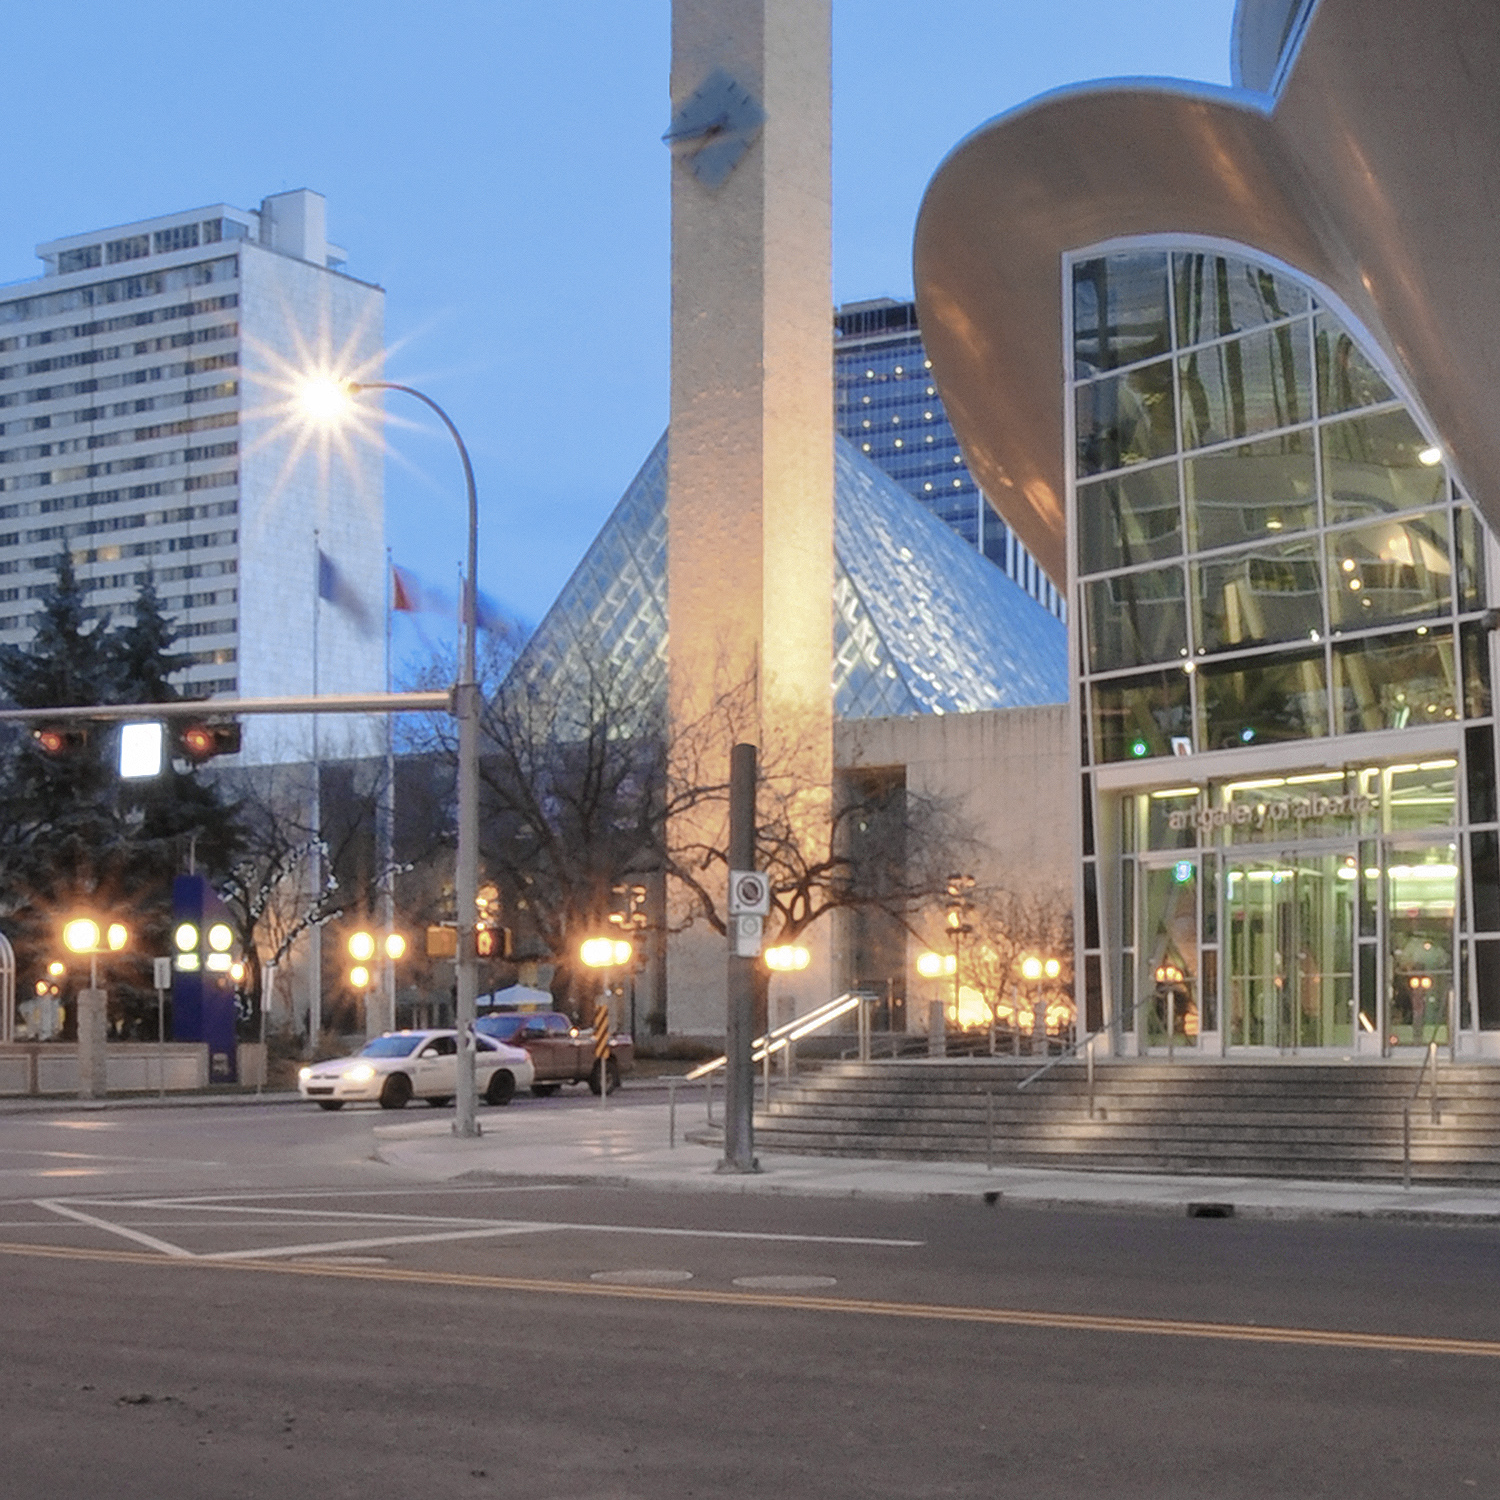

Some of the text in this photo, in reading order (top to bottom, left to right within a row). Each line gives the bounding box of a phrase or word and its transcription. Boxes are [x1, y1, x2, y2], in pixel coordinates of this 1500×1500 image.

[1168, 803, 1199, 830] art
[1200, 800, 1266, 832] gallery
[1295, 791, 1371, 819] alberta
